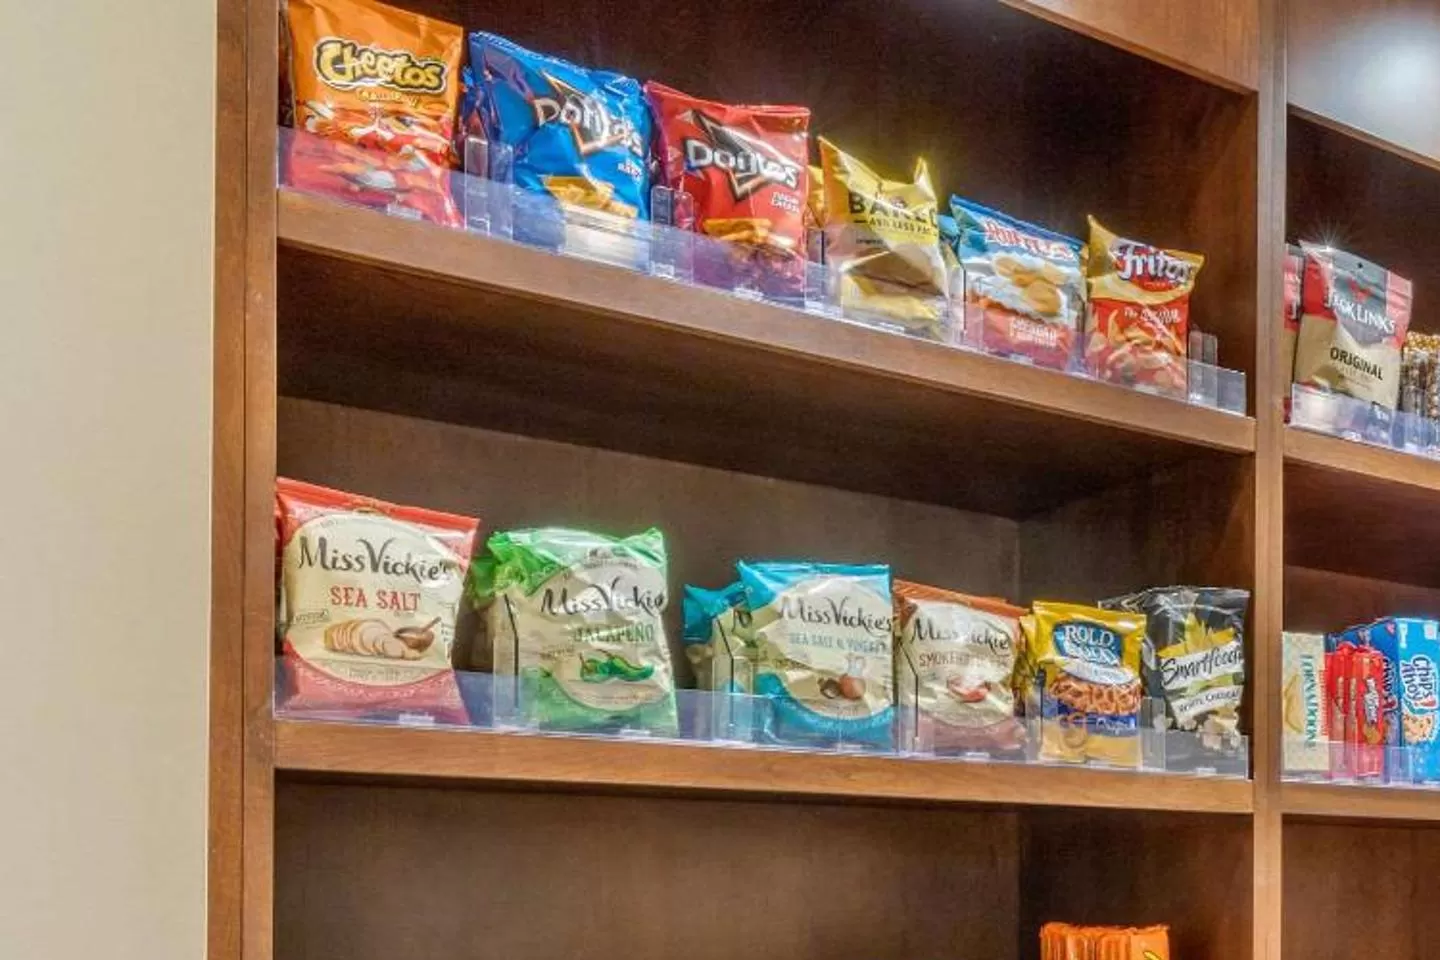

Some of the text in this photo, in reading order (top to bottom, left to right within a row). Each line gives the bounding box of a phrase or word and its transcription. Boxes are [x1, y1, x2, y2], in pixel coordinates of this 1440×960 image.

[316, 39, 444, 90] Cheetos
[533, 93, 644, 157] Doritos
[685, 138, 800, 190] Doritos
[1329, 346, 1384, 382] ORIGINAL
[298, 535, 366, 573] Miss
[329, 585, 422, 612] SEA SALT
[540, 586, 603, 616] Miss
[777, 594, 831, 625] Miss
[1064, 624, 1115, 647] ROLD
